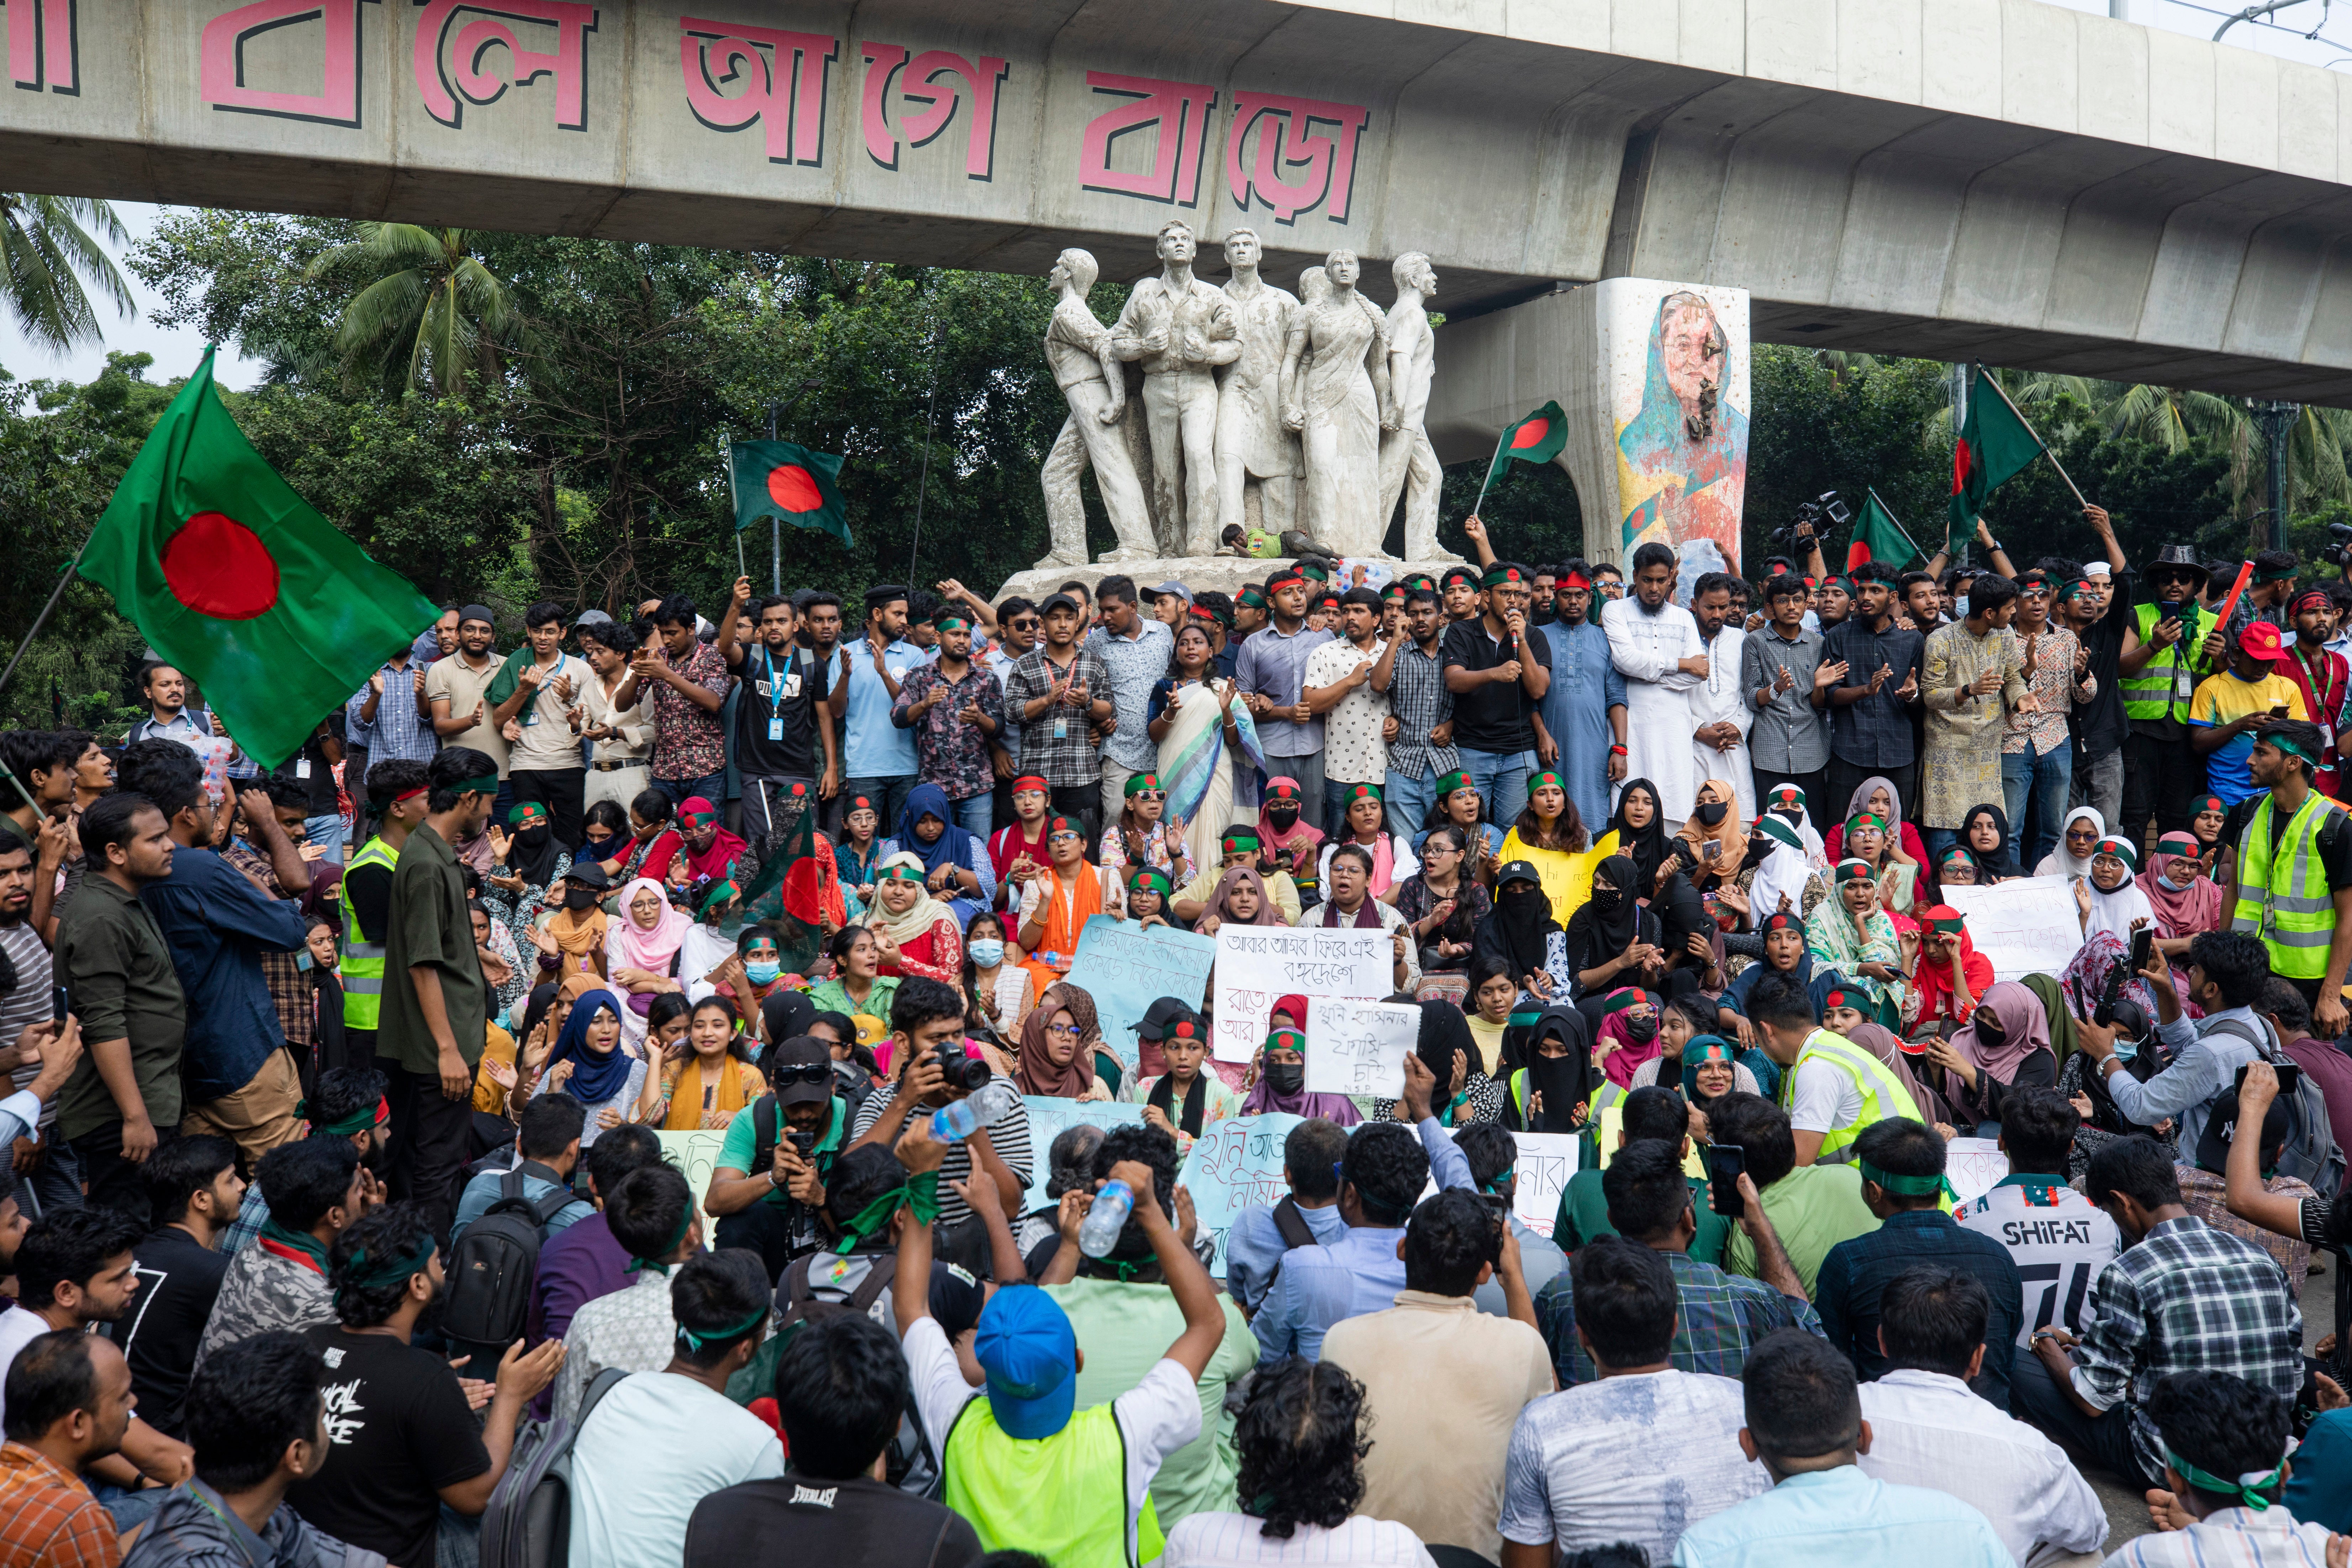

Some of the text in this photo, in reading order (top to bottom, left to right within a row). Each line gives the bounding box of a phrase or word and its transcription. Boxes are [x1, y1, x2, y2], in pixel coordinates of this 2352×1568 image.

[680, 16, 1009, 182] আগে
[1079, 70, 1369, 227] বাড়ো
[1998, 883, 2063, 913] হাসিনার
[1090, 925, 1211, 973] আমাদের ইনকিলাব
[1226, 933, 1379, 960] আবার আসিব ফিরে এই
[1990, 922, 2069, 956] দিন শেষ
[1129, 957, 1162, 990] নিবে
[1164, 970, 1207, 1001] কারা?
[1284, 962, 1357, 987] বঙ্গদেশে
[1226, 988, 1266, 1015] রাতে
[1218, 1019, 1254, 1043] আর
[1318, 1004, 1408, 1031] খুনি হাসিনার
[1353, 1059, 1390, 1082] চাই
[1200, 1119, 1260, 1184] খুনি
[789, 1484, 838, 1509] EVERLAST
